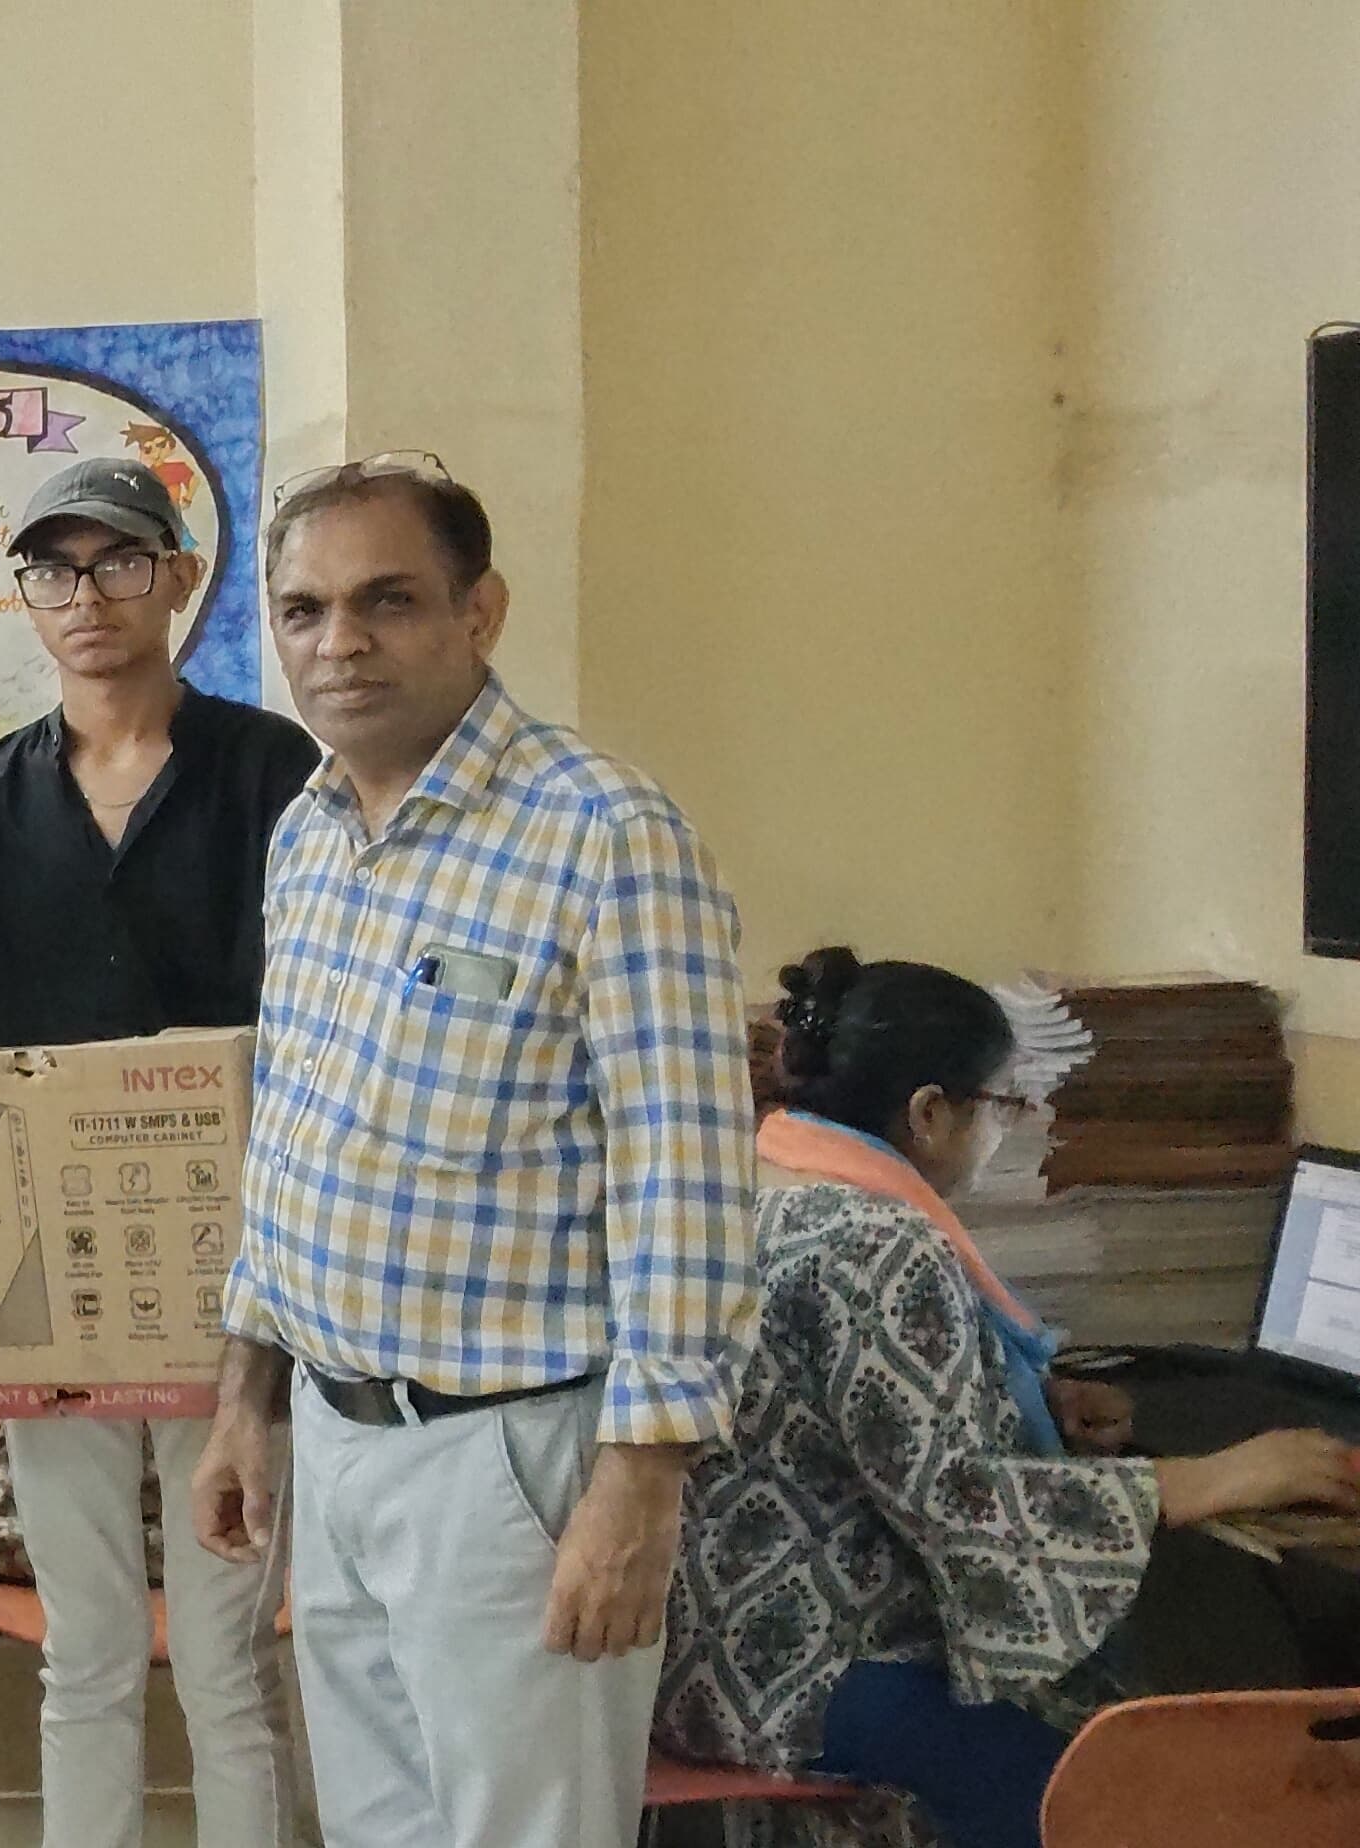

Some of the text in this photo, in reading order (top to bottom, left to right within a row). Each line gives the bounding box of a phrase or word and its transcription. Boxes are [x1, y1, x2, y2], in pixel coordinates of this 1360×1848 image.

[140, 1113, 177, 1130] SMPS
[181, 1112, 191, 1127] &
[194, 1111, 221, 1126] USB
